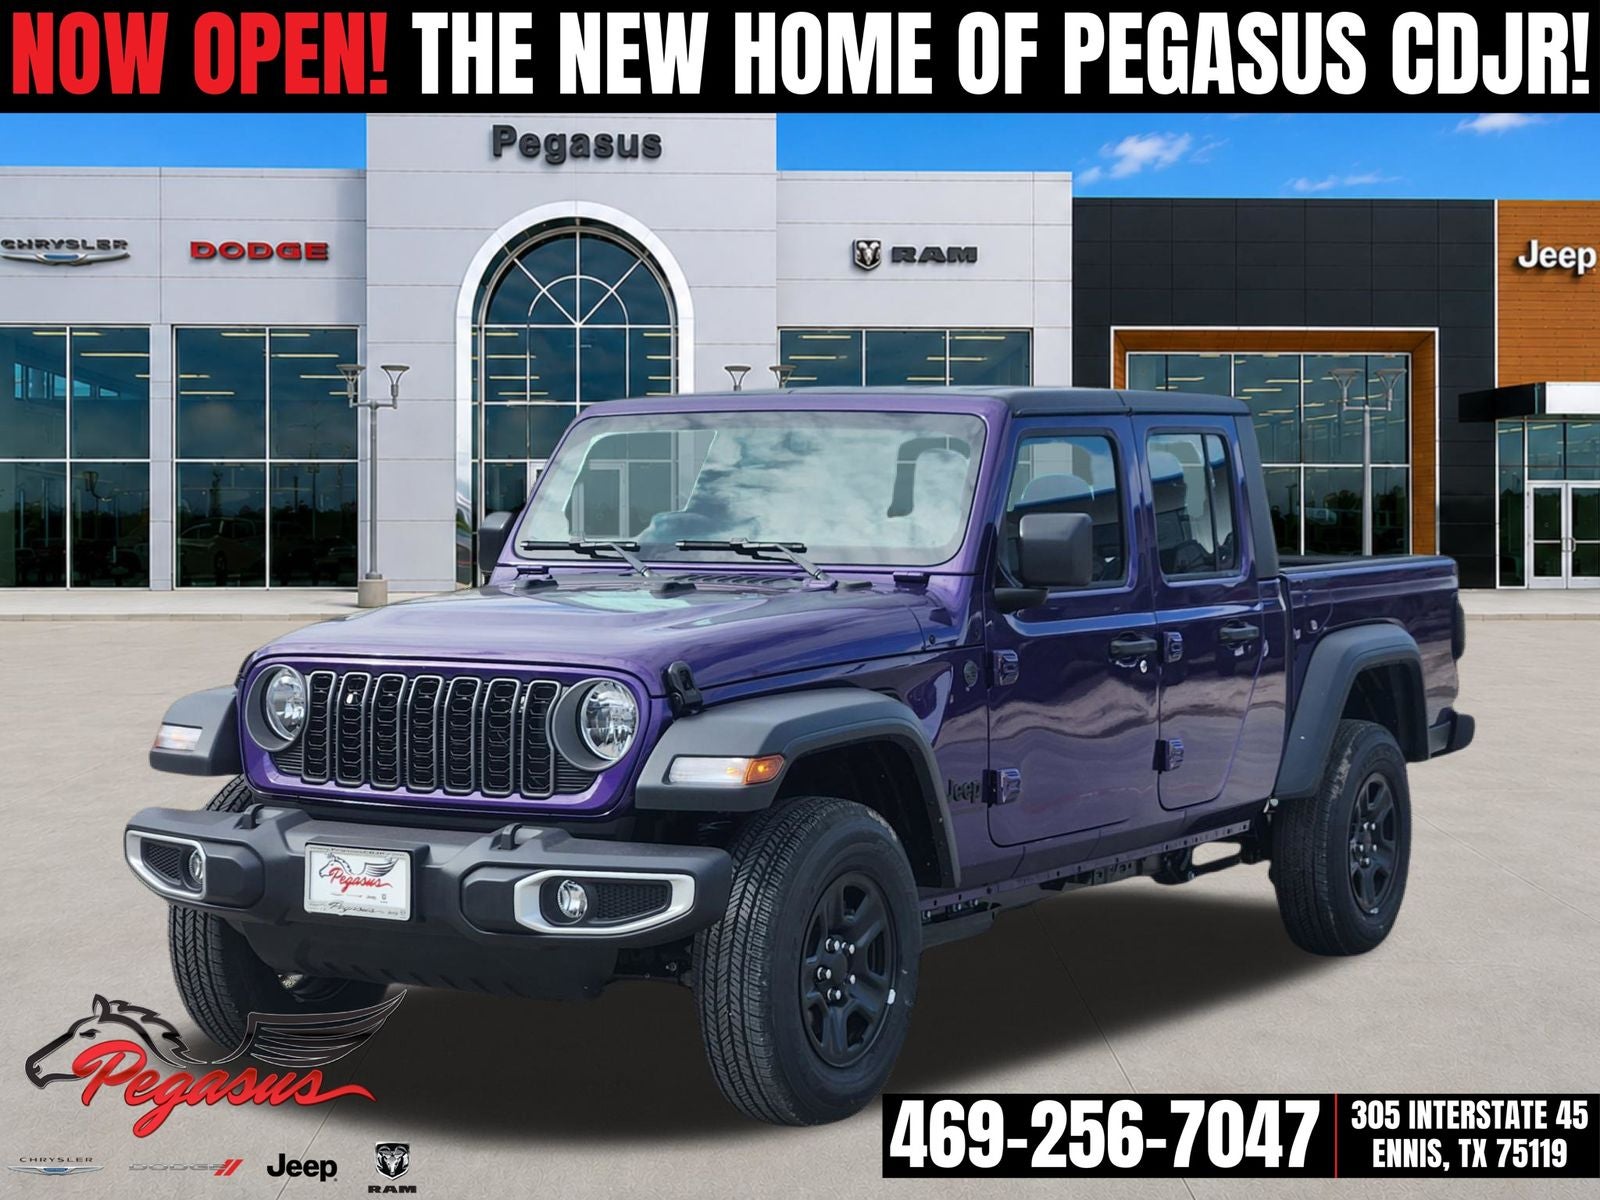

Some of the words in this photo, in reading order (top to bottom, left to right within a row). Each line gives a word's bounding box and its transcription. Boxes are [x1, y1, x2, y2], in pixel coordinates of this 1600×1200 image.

[492, 124, 662, 167] Pegasus
[1, 239, 129, 251] CHRYSLER
[190, 240, 328, 261] DODGE
[891, 246, 978, 264] RAM
[1518, 239, 1597, 275] Jeep
[947, 779, 981, 803] Jeep
[328, 866, 393, 893] Pegasus
